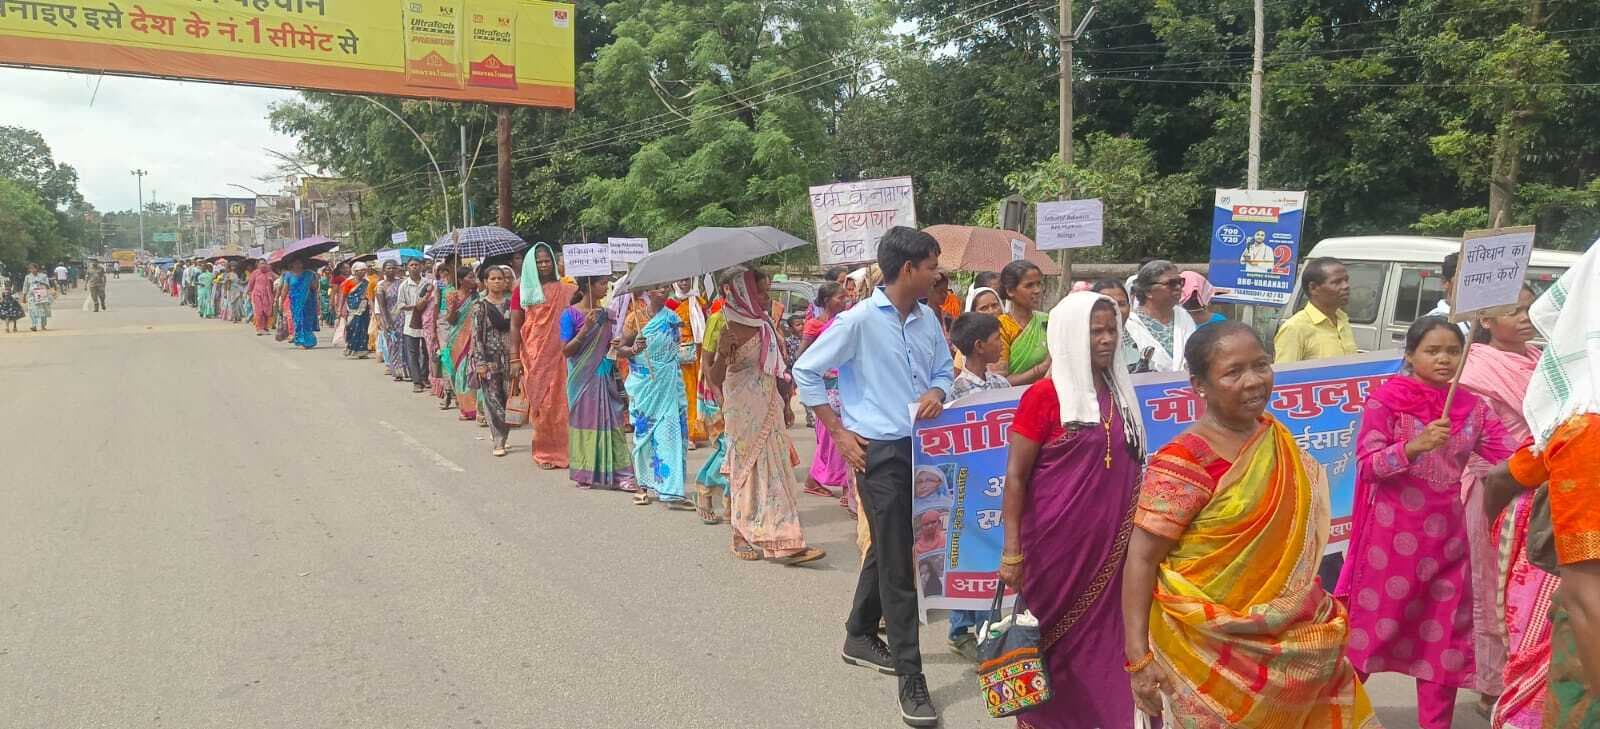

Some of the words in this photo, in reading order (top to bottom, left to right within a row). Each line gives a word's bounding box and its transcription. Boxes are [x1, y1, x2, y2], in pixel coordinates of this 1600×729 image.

[82, 2, 124, 31] इसे
[128, 5, 177, 36] देश
[183, 11, 211, 38] के
[266, 22, 333, 52] सीमेंट
[338, 28, 359, 55] से
[411, 18, 455, 30] UltraTech
[473, 28, 511, 38] UltraTech
[831, 208, 897, 232] अत्याचार
[1238, 206, 1273, 216] GOAL
[1222, 236, 1239, 244] 720
[1272, 245, 1292, 273] 2
[1467, 244, 1505, 263] संविधान
[1511, 243, 1527, 257] का
[1463, 271, 1493, 287] सम्मान
[1497, 262, 1520, 281] करो
